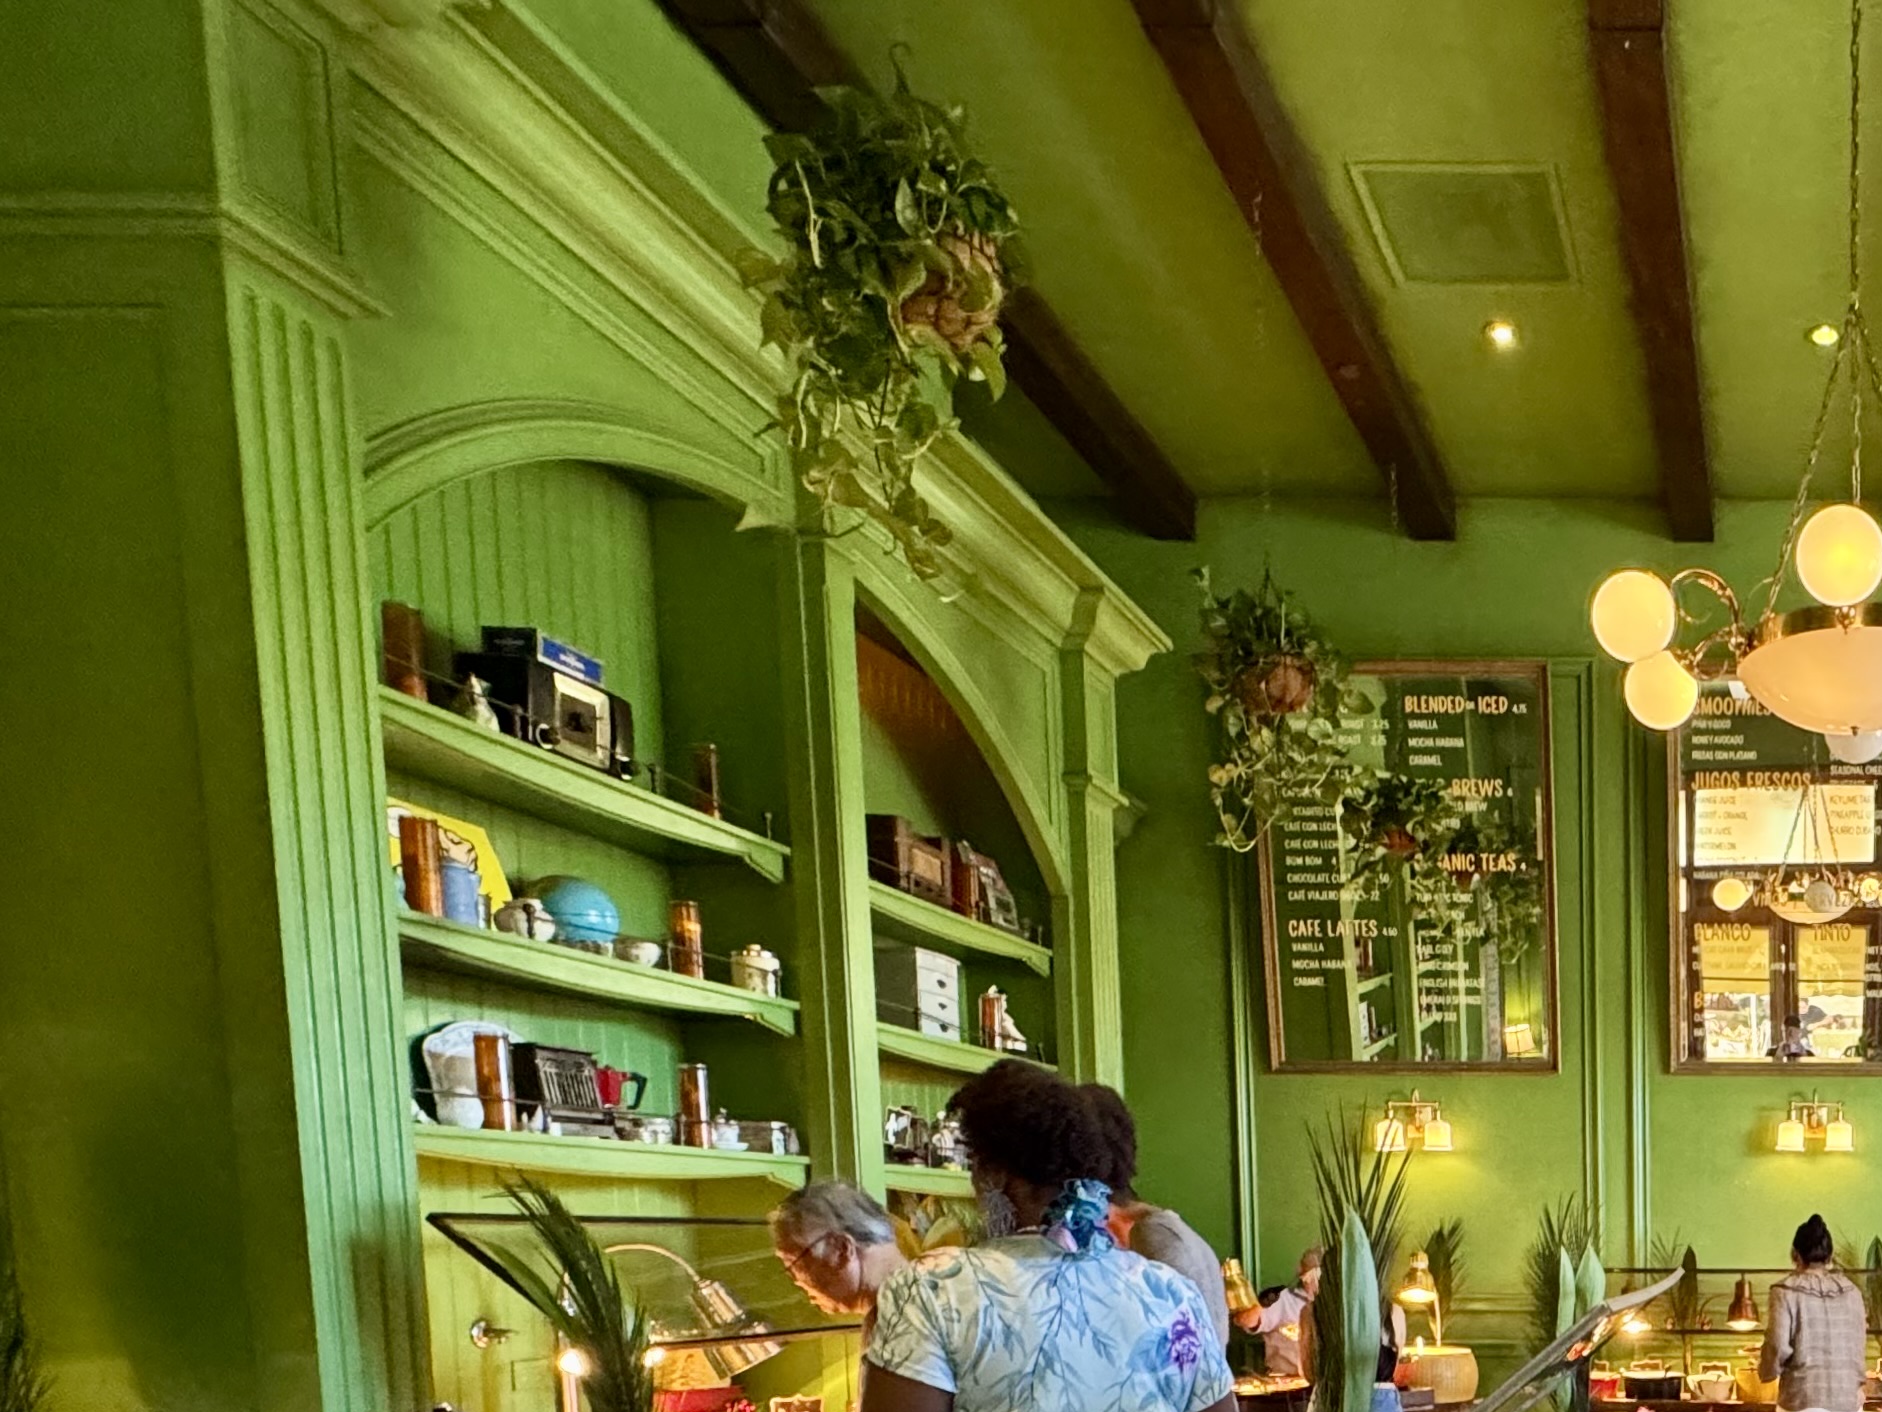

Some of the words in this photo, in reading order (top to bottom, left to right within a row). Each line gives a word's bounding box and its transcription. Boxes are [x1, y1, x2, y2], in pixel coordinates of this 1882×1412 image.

[1404, 695, 1465, 714] BLENDED
[1478, 695, 1509, 715] ICED
[1407, 718, 1439, 730] VANILLA
[1408, 737, 1435, 748] MOCHA
[1434, 737, 1465, 748] HABANA
[1409, 754, 1443, 766] CARAMEL
[1830, 765, 1864, 775] SEASONAL
[1691, 772, 1740, 790] JUGOS
[1746, 771, 1811, 790] FRESCOS
[1451, 778, 1504, 797] BREWS
[1302, 821, 1318, 832] CON
[1480, 853, 1517, 872] TEAS
[1287, 872, 1330, 884] CHOCOLATE
[1327, 919, 1379, 938] LATTES
[1694, 923, 1751, 942] BLANCO
[1814, 922, 1852, 942] TINTO
[1291, 942, 1325, 953] VANILLA
[1291, 959, 1321, 970] MOCHA
[1293, 976, 1325, 987] CARAMEL
